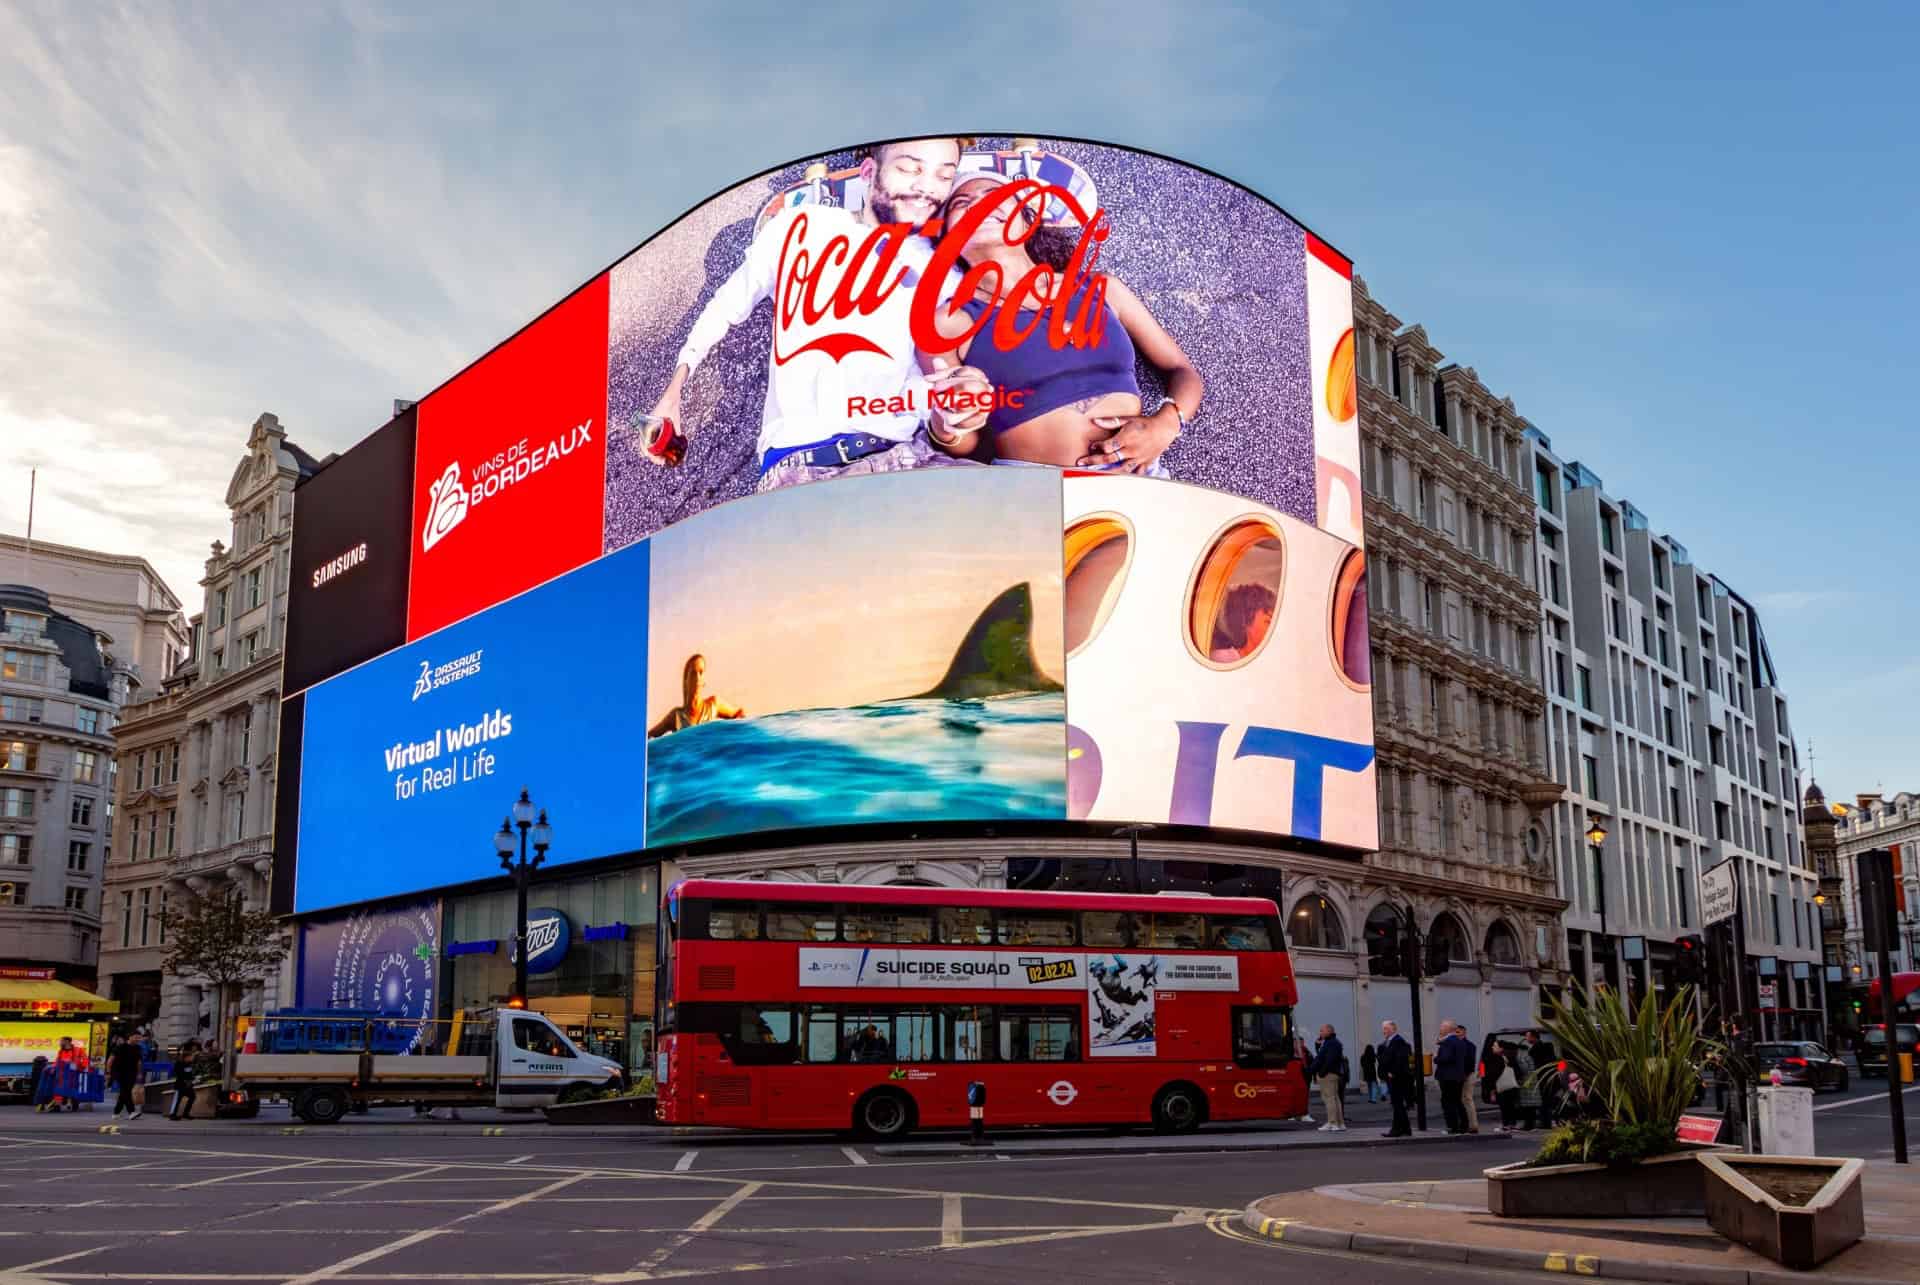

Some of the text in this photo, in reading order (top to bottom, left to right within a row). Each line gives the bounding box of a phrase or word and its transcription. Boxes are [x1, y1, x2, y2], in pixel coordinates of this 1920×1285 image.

[774, 179, 1110, 366] Coca-Cola
[848, 384, 1025, 418] Real Magic
[471, 418, 593, 506] BORDEAUX
[472, 438, 528, 481] VINS DE
[313, 542, 367, 588] SAMSUNG
[434, 649, 484, 677] DASSAULT
[384, 708, 512, 772] Virtual Worlds
[395, 747, 496, 801] for Real Life
[359, 919, 372, 944] YOU
[876, 961, 1011, 976] SUICIDE SQUAD
[1028, 960, 1076, 983] 02.02.24
[1234, 1082, 1257, 1098] Go
